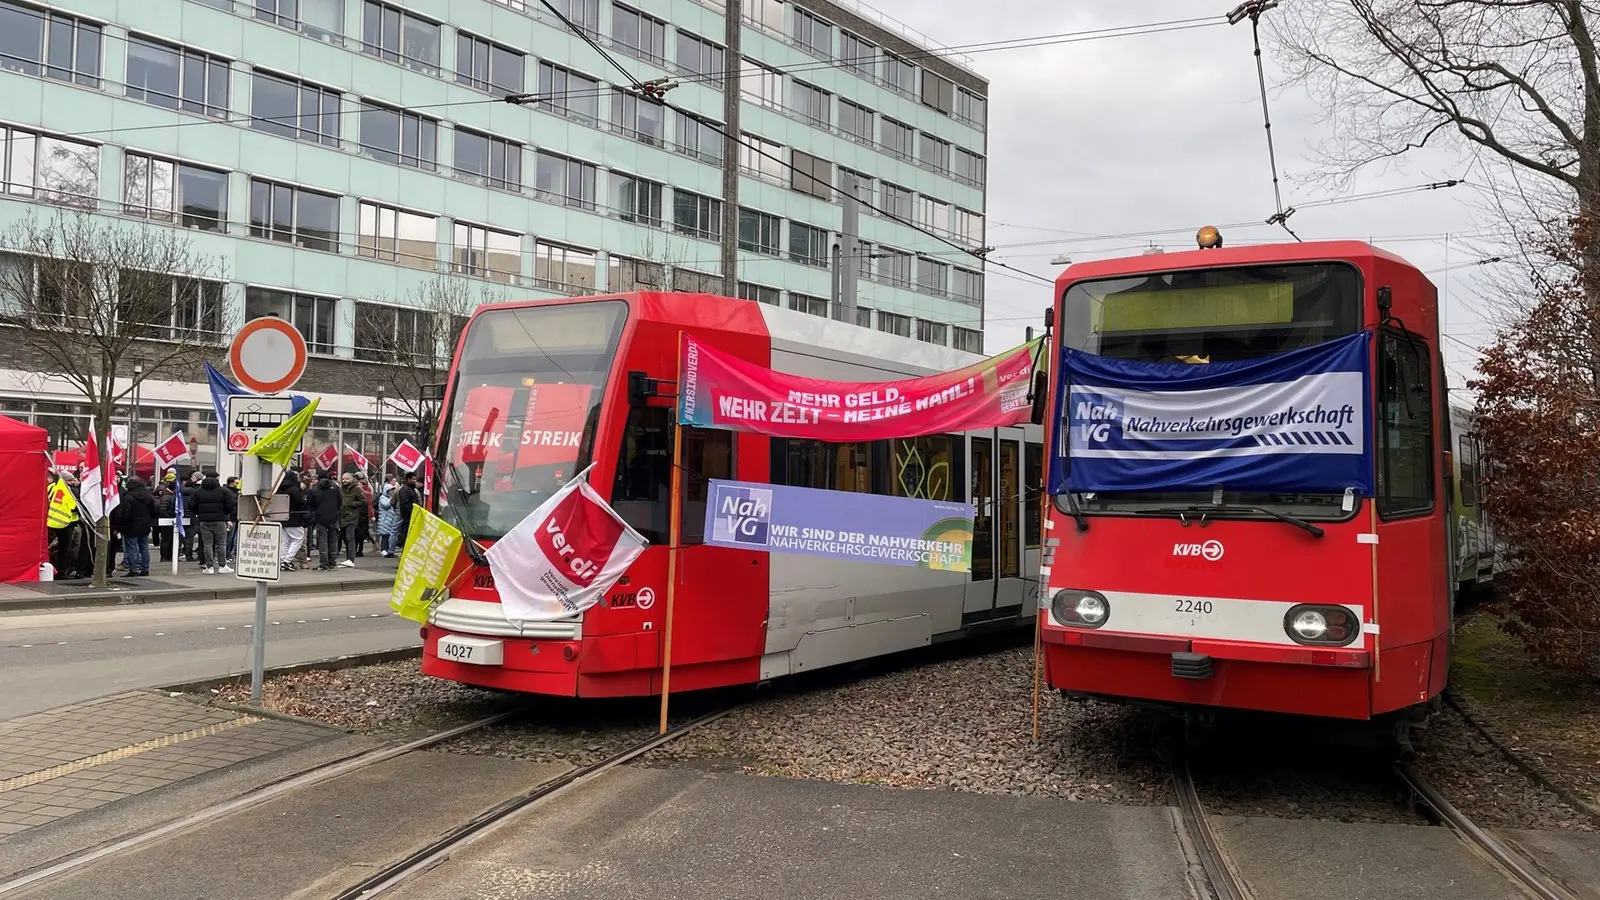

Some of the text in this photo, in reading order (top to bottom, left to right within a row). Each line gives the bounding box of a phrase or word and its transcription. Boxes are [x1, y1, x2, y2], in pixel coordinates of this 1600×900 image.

[684, 339, 698, 422] #WIRSINDVERDI
[719, 395, 767, 422] MEHR
[770, 401, 823, 424] ZEIT
[843, 401, 912, 424] MEINE
[915, 377, 976, 411] WAHL!
[788, 387, 906, 408] MEHR GELD,
[1075, 401, 1119, 421] Nah
[1126, 404, 1355, 436] Nahverkehrsgewerkschaft
[457, 430, 503, 448] STREIK
[521, 430, 583, 447] STREIK
[1080, 423, 1112, 442] VG
[721, 495, 767, 518] Nah
[727, 515, 759, 536] VG
[546, 517, 598, 580] ver.di
[770, 524, 963, 555] WIR SIND DER NAHVERKEHR
[1172, 543, 1202, 556] KVB
[769, 537, 962, 565] NAHVERKEHRSGEWERKSCHAFT
[611, 593, 637, 607] KVB
[1175, 599, 1213, 614] 2240
[445, 643, 473, 659] 4027
